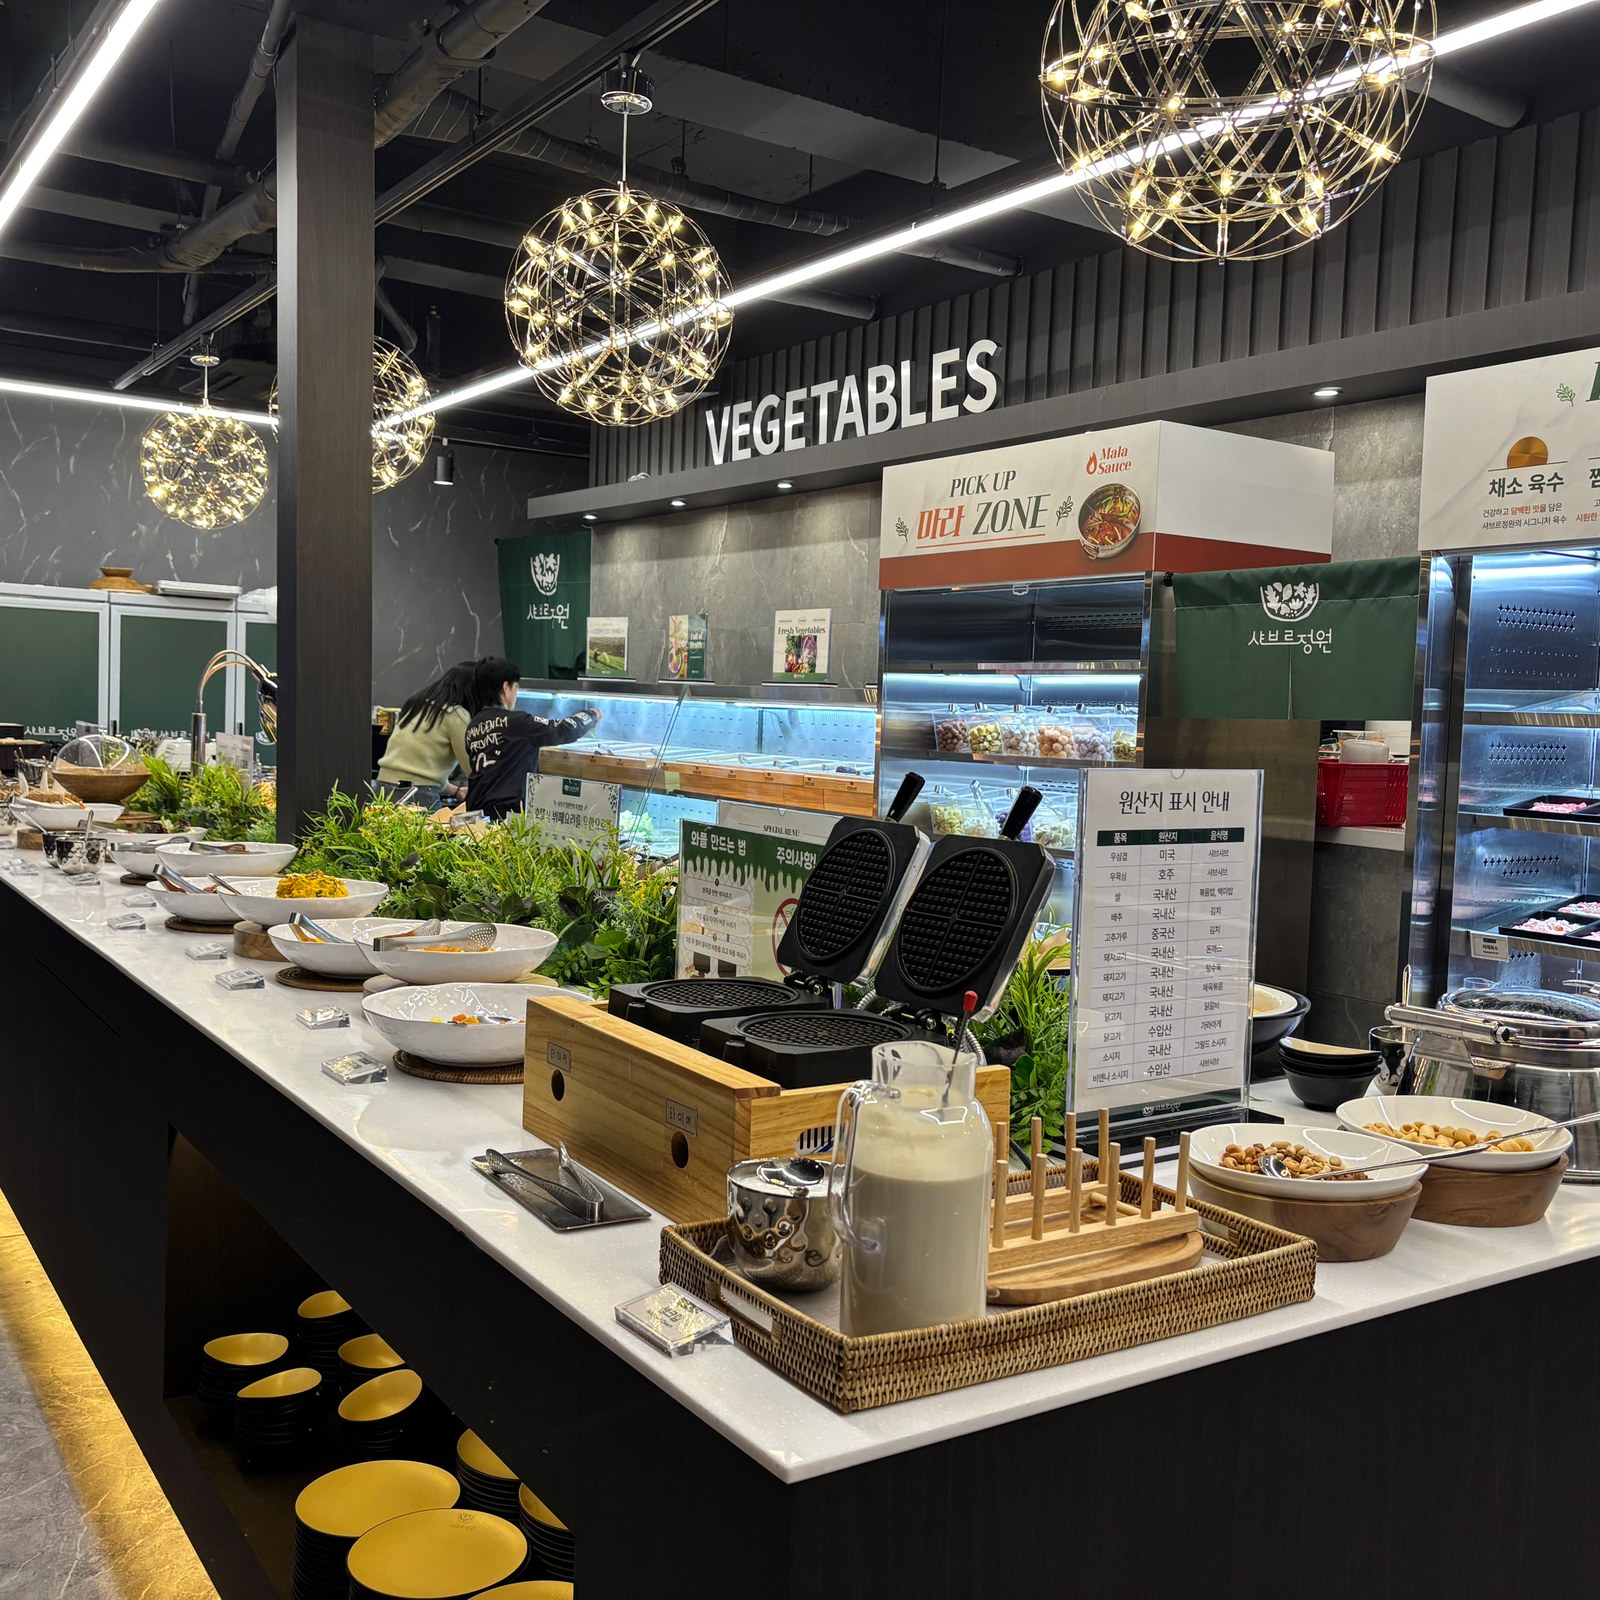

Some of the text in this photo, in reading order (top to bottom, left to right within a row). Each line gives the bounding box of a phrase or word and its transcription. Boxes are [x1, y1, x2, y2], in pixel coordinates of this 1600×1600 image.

[704, 338, 999, 466] VEGETABLES
[1099, 445, 1129, 461] Mala
[1097, 459, 1133, 476] Sauce
[949, 469, 1017, 498] PICK UP
[1488, 476, 1524, 498] 채소
[1527, 471, 1565, 494] 육수
[971, 493, 1053, 536] ZONE
[1482, 502, 1563, 519] 건강하고 담백한 맛을 담은
[1576, 511, 1598, 523] 시원한
[1523, 516, 1551, 527] 시그니처
[1552, 515, 1567, 525] 육수
[1247, 627, 1333, 655] 샤브르정원
[1118, 790, 1230, 815] 원산지 표시 안내
[762, 823, 801, 838] SPECIAL MENU
[1158, 830, 1178, 842] 원산지
[690, 829, 747, 857] 와플 만드는 법
[1159, 849, 1175, 861] 미국
[1158, 869, 1175, 881] 호주
[1152, 888, 1177, 901] 국내산
[1152, 908, 1176, 920] 국내산
[1209, 906, 1221, 916] 김치
[1151, 927, 1175, 940] 중국산
[1209, 926, 1221, 935] 김치
[1150, 947, 1175, 960] 국내산
[1102, 972, 1127, 982] 돼지고기
[1149, 966, 1174, 979] 국내산
[1102, 991, 1126, 1002] 돼지고기
[1149, 986, 1174, 999] 국내산
[1148, 1005, 1173, 1019] 국내산
[1147, 1024, 1172, 1038] 수입산
[1102, 1051, 1120, 1062] 소시지
[1147, 1044, 1172, 1058] 국내산
[1110, 1069, 1129, 1081] 소시지
[1146, 1063, 1171, 1078] 수입산
